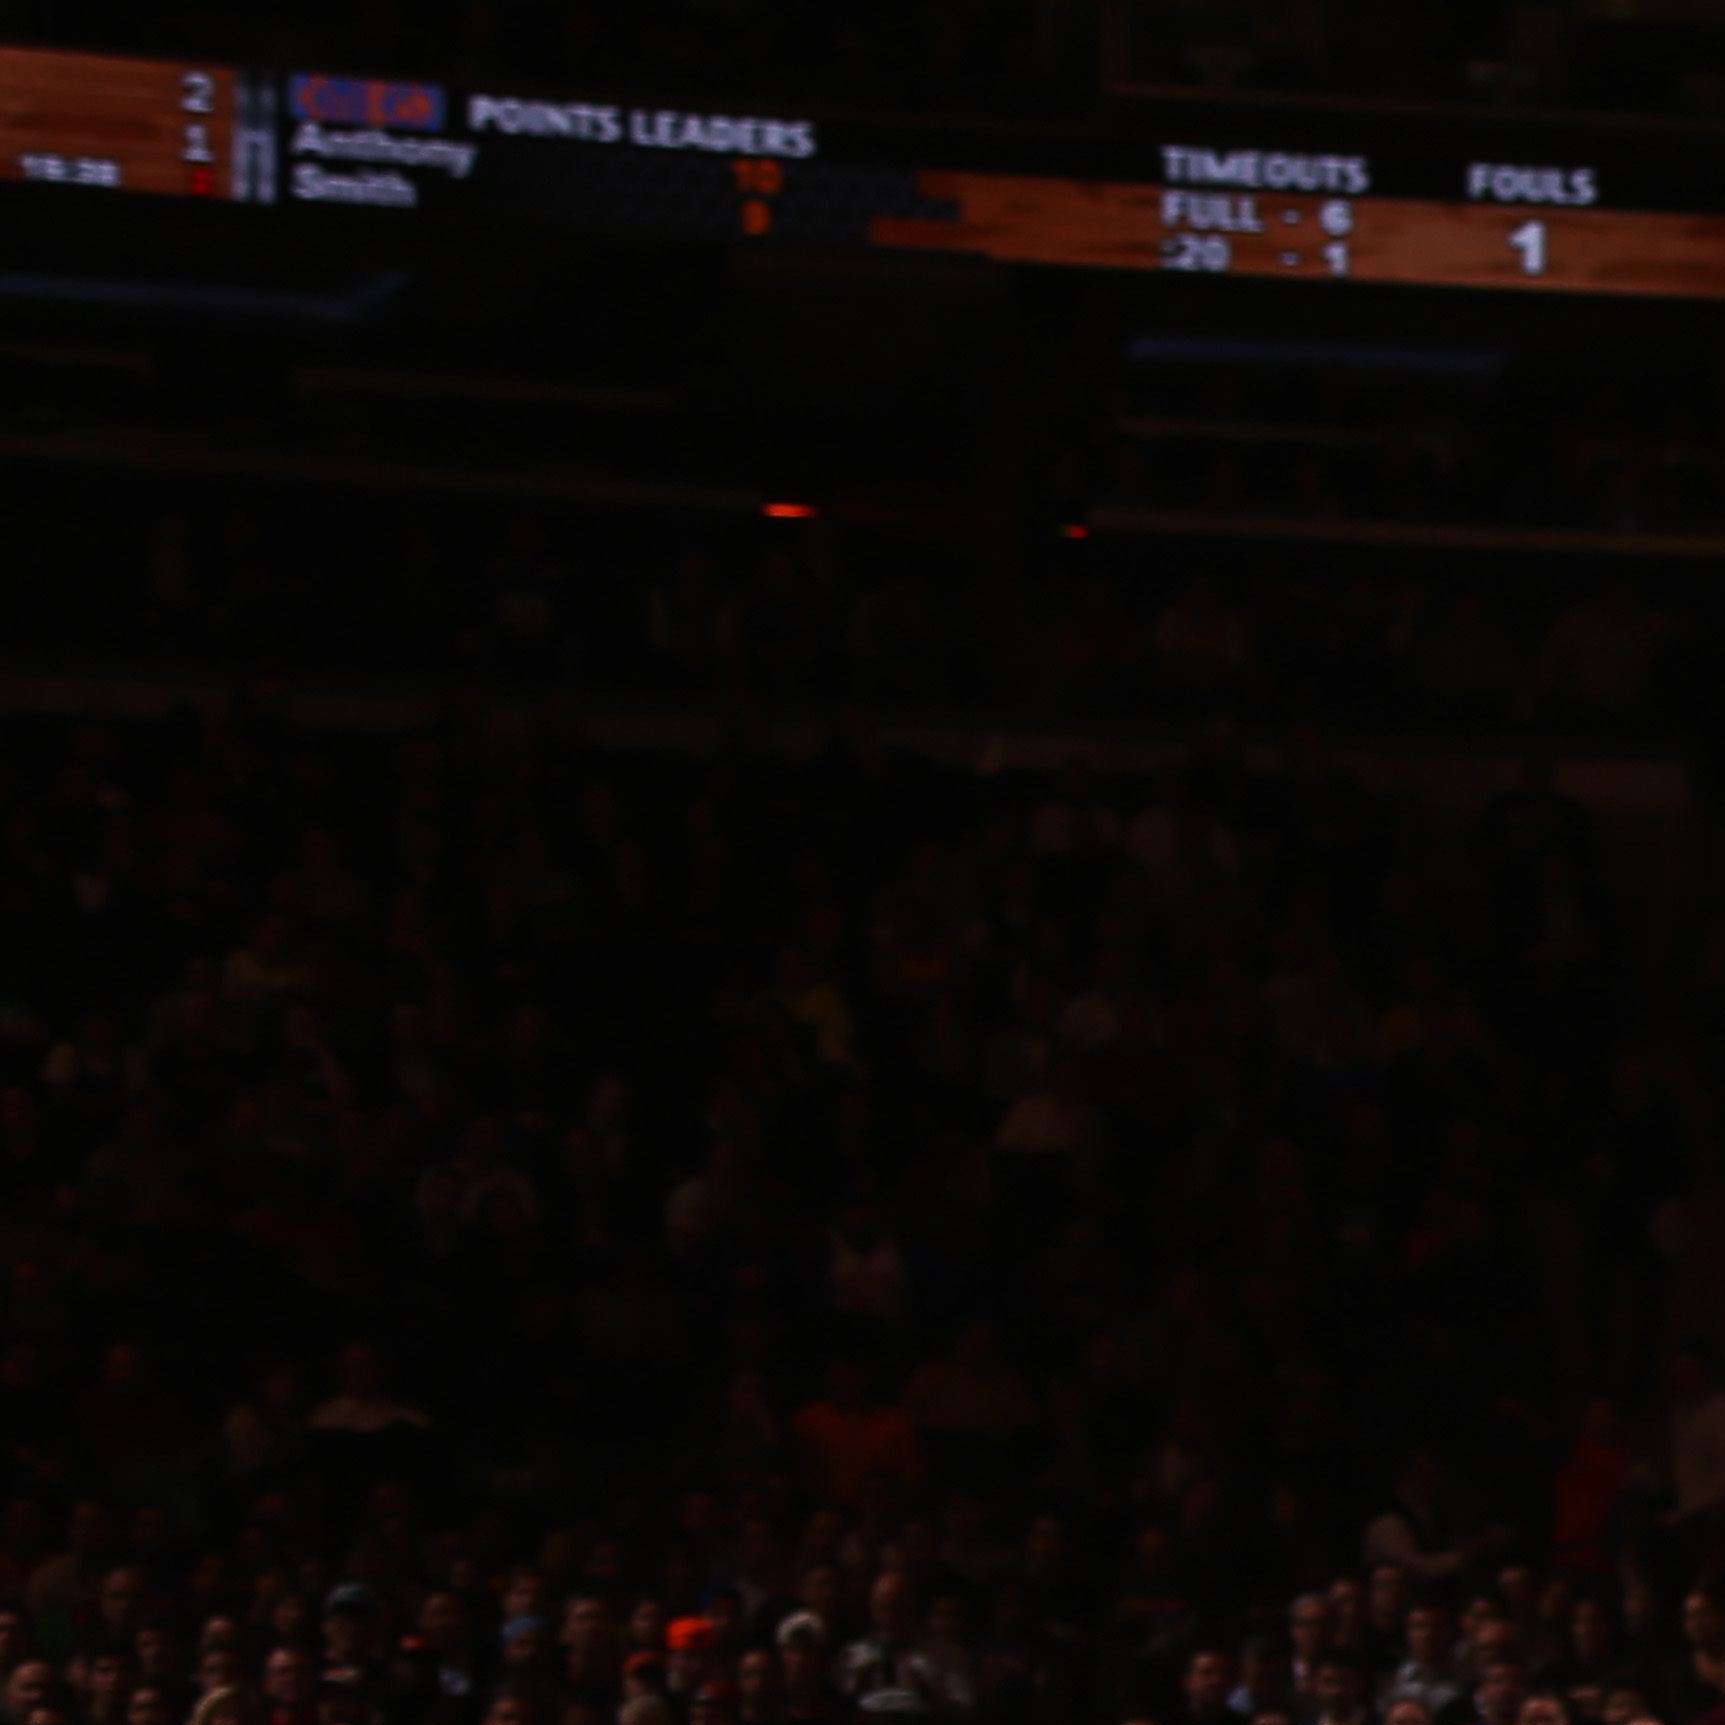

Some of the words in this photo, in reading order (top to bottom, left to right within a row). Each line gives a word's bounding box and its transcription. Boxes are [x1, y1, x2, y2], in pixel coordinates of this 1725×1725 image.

[467, 93, 622, 144] POINTS
[629, 108, 816, 158] LEADERS
[291, 122, 478, 179] Anthony
[1160, 144, 1370, 195] TIMEOUTS
[291, 162, 418, 208] Smith
[1466, 162, 1599, 207] FOULS
[1160, 189, 1264, 233] FULL
[1321, 240, 1351, 277] 1
[1508, 219, 1547, 276] 1
